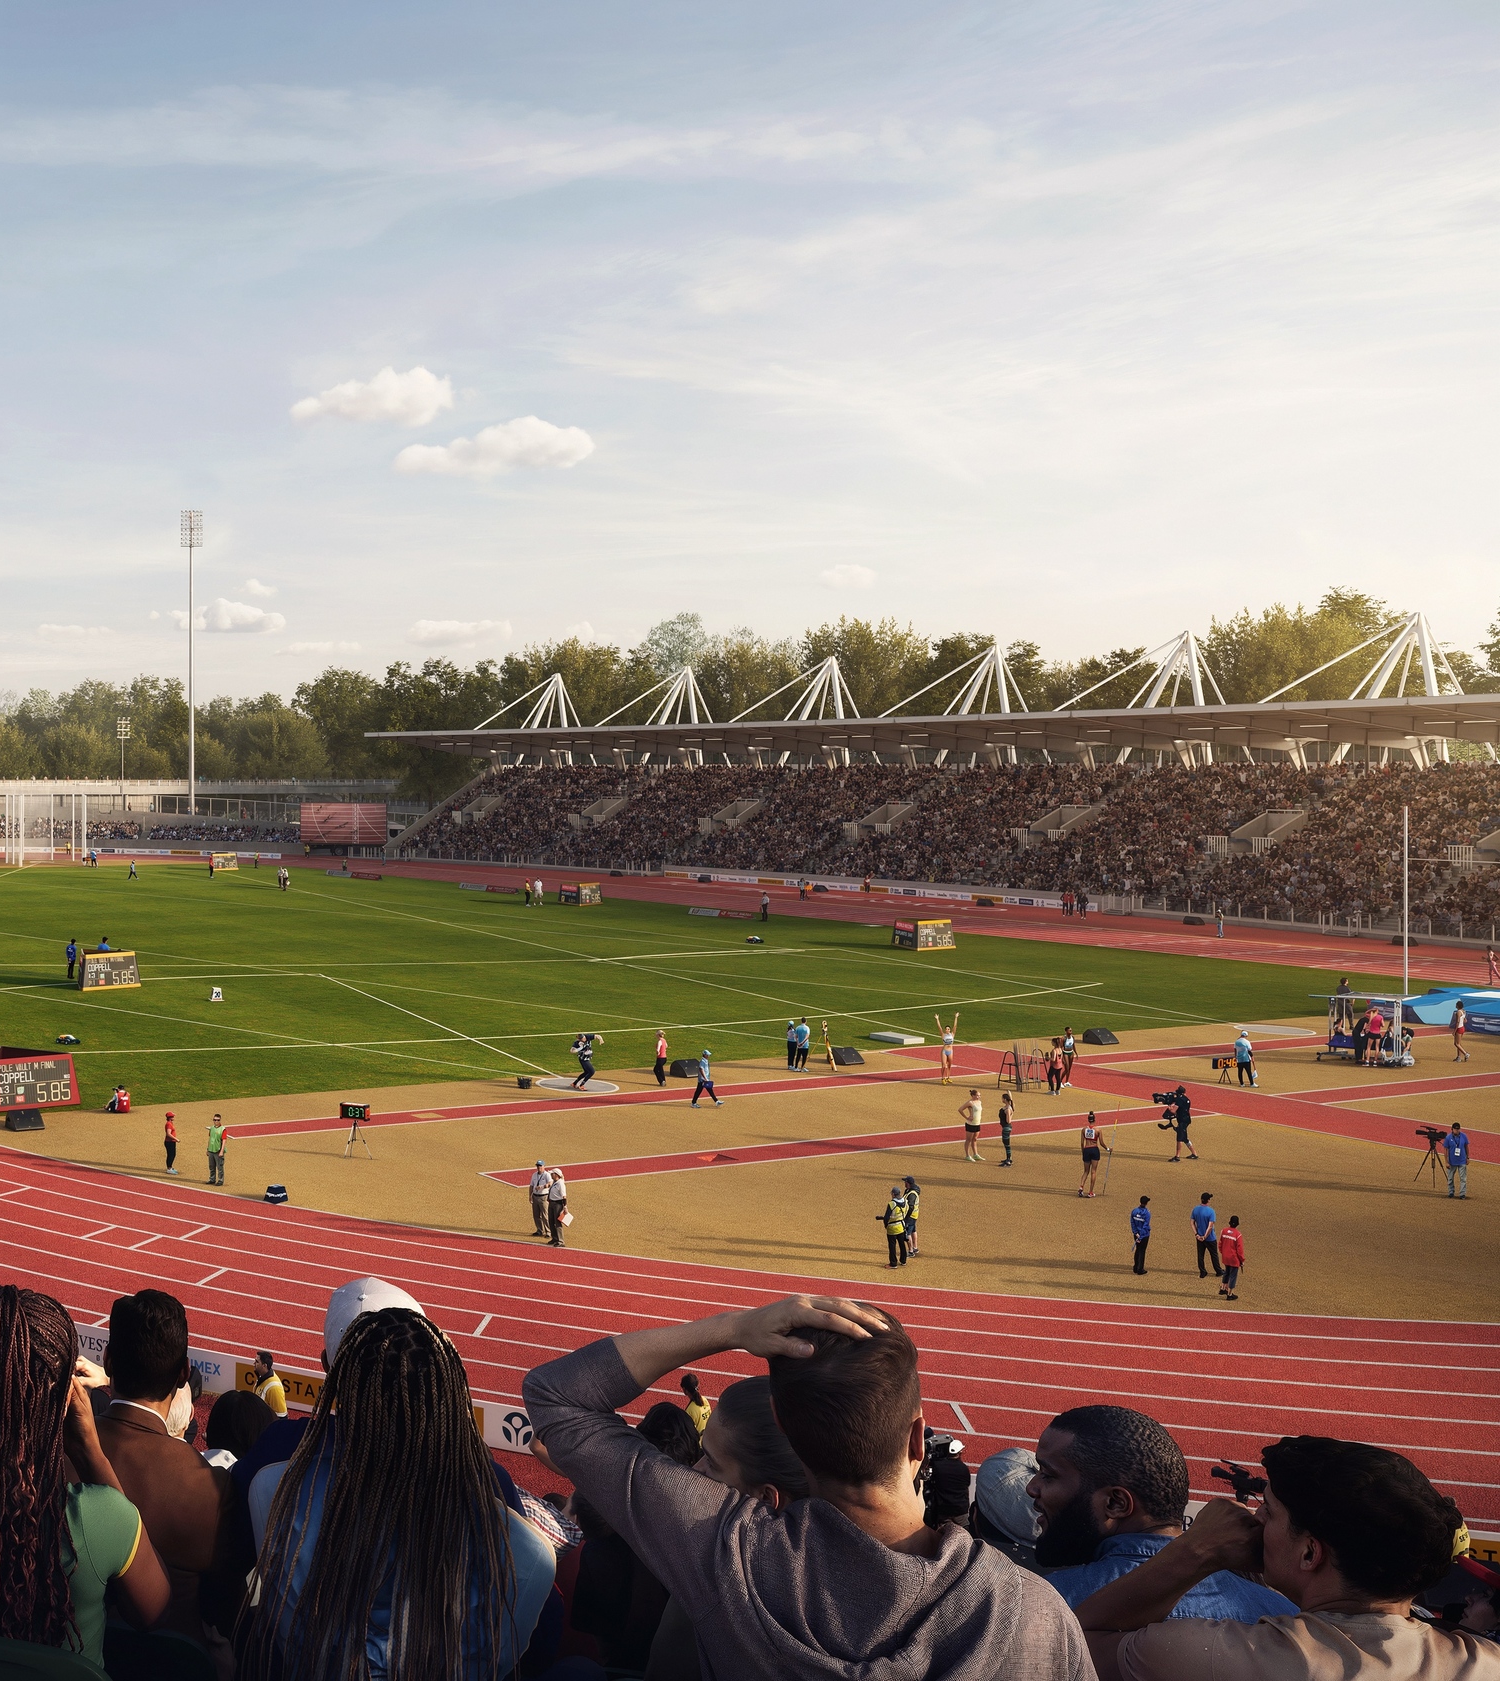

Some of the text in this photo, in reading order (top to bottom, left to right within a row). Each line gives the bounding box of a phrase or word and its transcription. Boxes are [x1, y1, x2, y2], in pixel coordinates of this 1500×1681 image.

[936, 935, 953, 947] 5.85
[88, 963, 111, 971] COPPELL
[112, 970, 135, 985] 5.85
[15, 1062, 31, 1071] VAULT
[33, 1062, 39, 1070] M
[1217, 1058, 1238, 1069] 0:46
[37, 1081, 71, 1102] 5.85
[348, 1106, 365, 1118] 0:37
